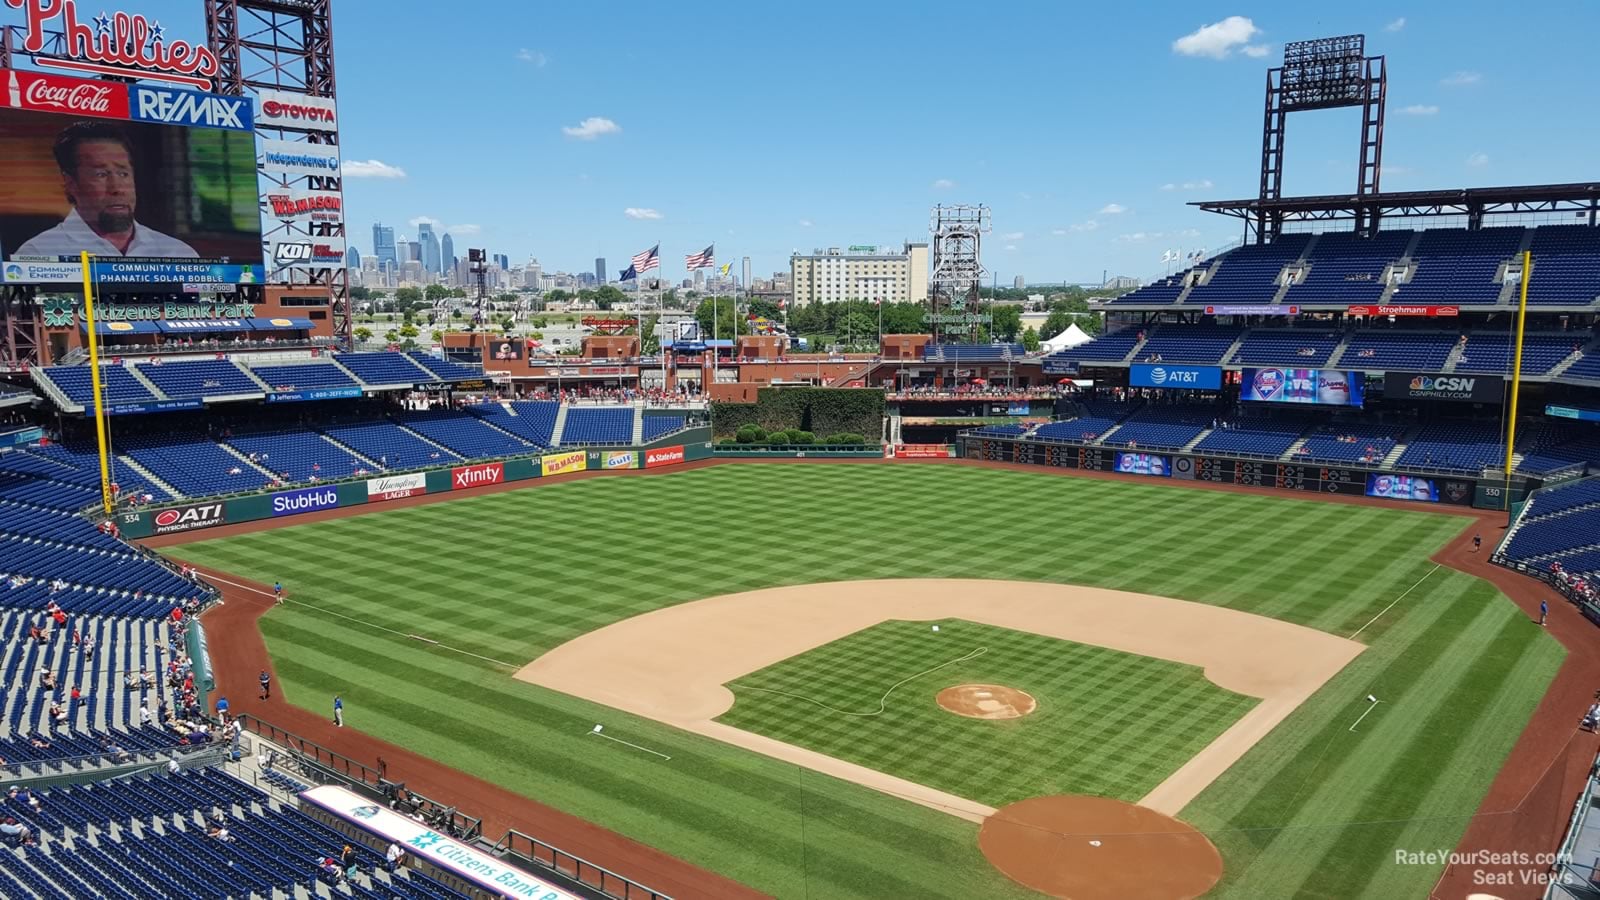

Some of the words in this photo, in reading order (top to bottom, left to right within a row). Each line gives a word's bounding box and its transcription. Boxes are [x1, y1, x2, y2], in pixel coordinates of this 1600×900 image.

[3, 0, 218, 77] Phillies
[26, 79, 112, 112] Coca-Cola
[138, 89, 244, 128] RE/MAX
[280, 104, 335, 123] TOYOTA
[266, 152, 327, 168] Independence
[28, 265, 82, 273] COMMUNIT
[112, 264, 171, 272] COMMUNITY
[175, 264, 211, 272] ENERGY
[101, 274, 150, 283] PHANATIC
[153, 274, 185, 283] SOLAR
[188, 274, 223, 283] BOBBLE
[78, 303, 161, 322] Citizens
[164, 302, 211, 319] Bank
[214, 301, 256, 318] Park
[1378, 306, 1427, 314] Stroehmann
[1169, 371, 1199, 382] AT&T
[1434, 377, 1475, 391] CSN
[1409, 390, 1472, 399] CSNPHILLY.COM
[608, 454, 633, 466] Gulf
[456, 467, 499, 486] xfinity
[375, 478, 418, 491] Yuengling
[385, 490, 411, 499] LAGER
[1485, 488, 1500, 496] 330
[274, 490, 337, 511] StubHub
[125, 514, 140, 524] 334
[179, 504, 222, 523] ATI
[158, 523, 189, 533] PHYSICAL
[190, 519, 220, 529] THERAPY
[435, 844, 496, 876] Citizens
[495, 871, 541, 897] Bank
